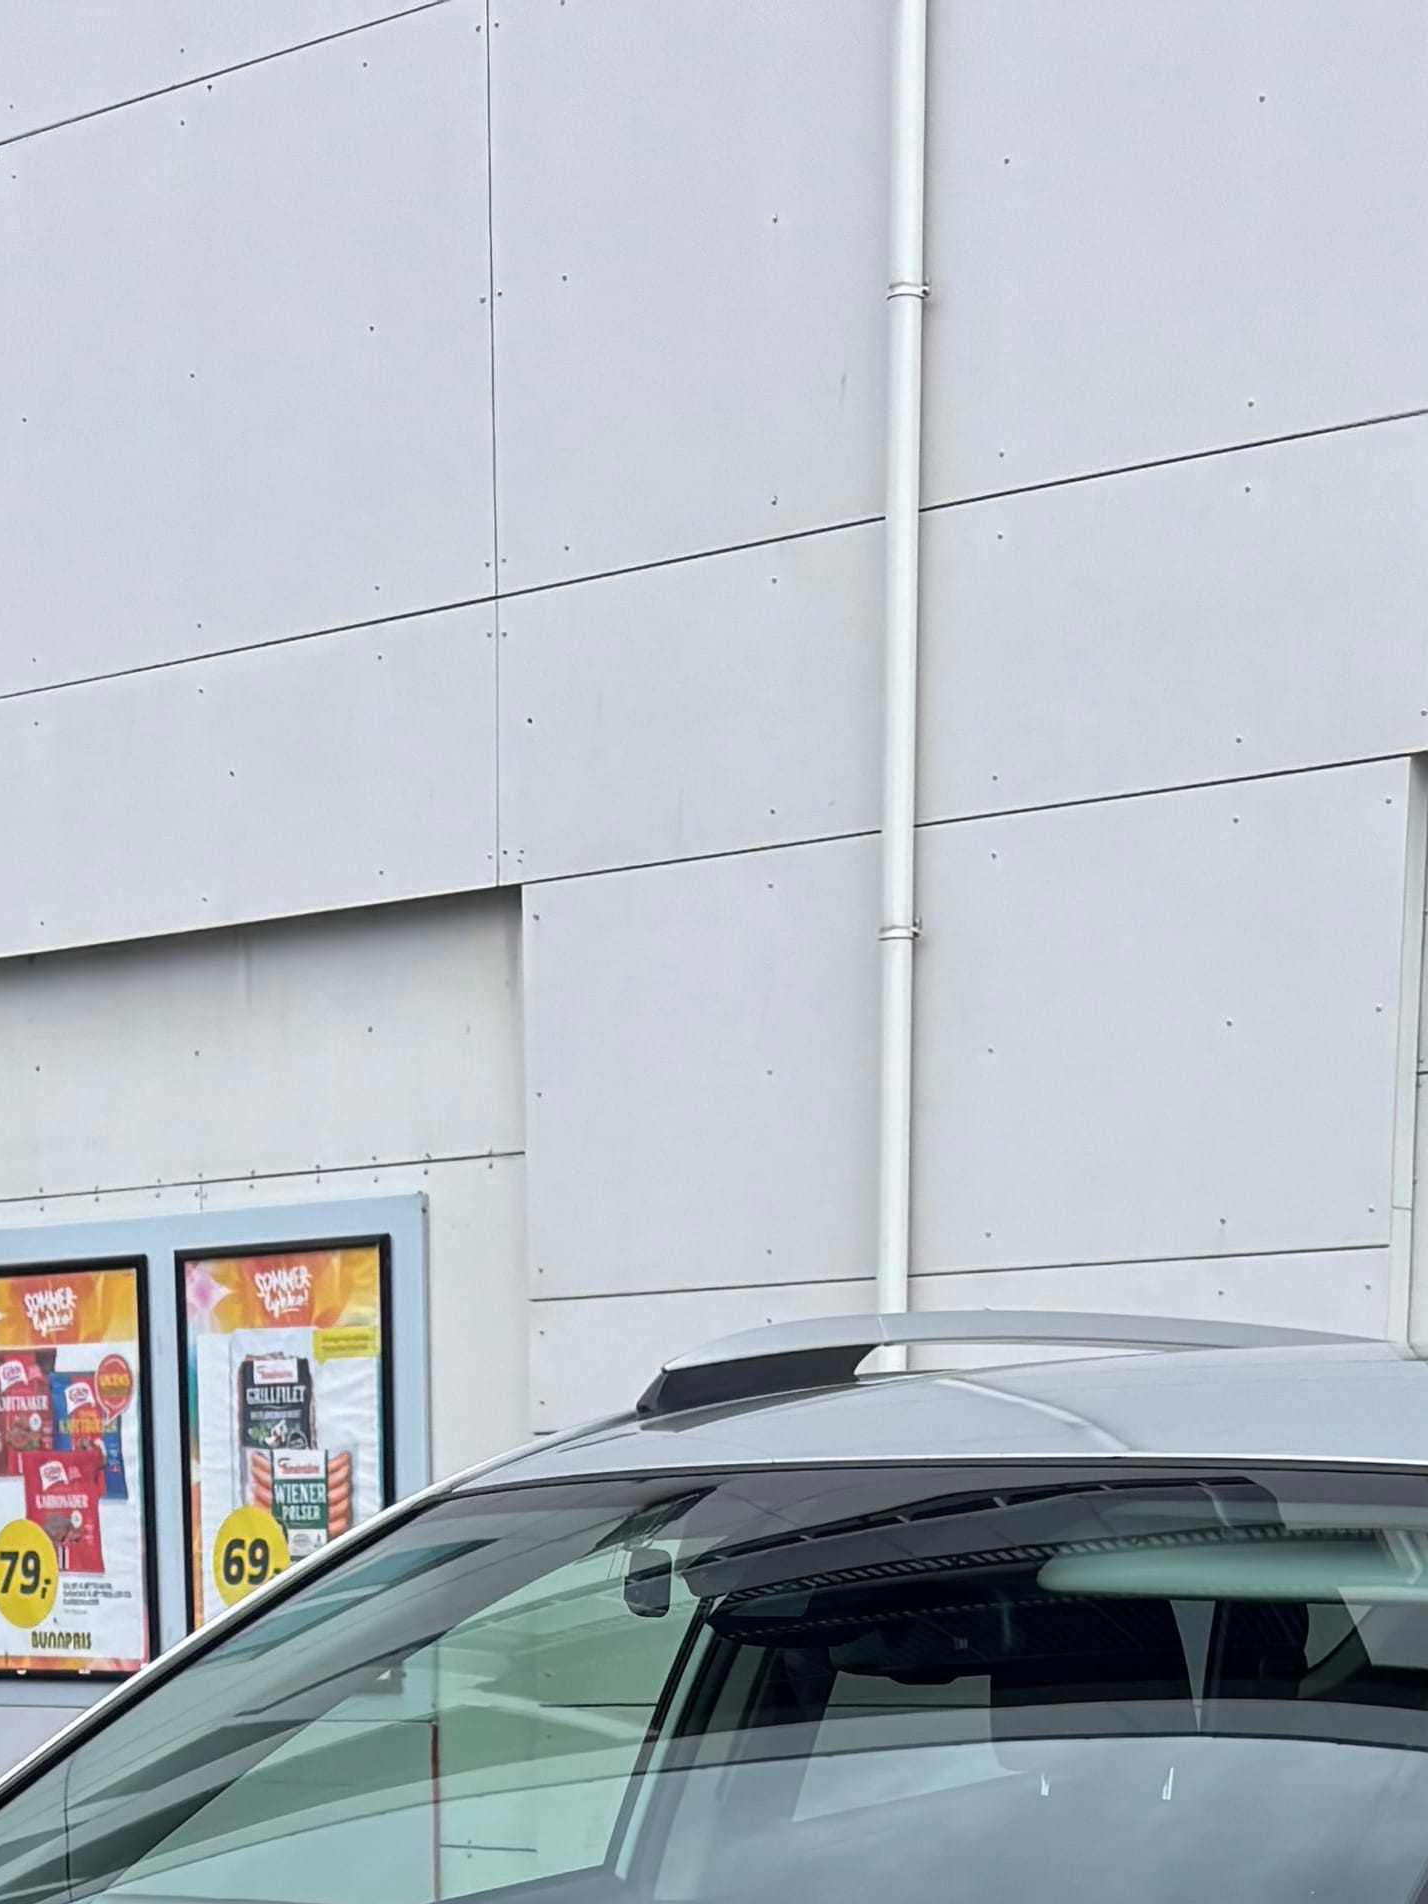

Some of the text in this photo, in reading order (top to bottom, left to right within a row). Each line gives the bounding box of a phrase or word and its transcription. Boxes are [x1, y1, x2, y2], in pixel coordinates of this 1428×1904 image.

[274, 1482, 326, 1504] WIENER
[282, 1504, 320, 1521] PØLSER
[223, 1538, 281, 1586] 69-
[0, 1550, 51, 1599] 79,-
[31, 1631, 92, 1650] BUNNPRIS
